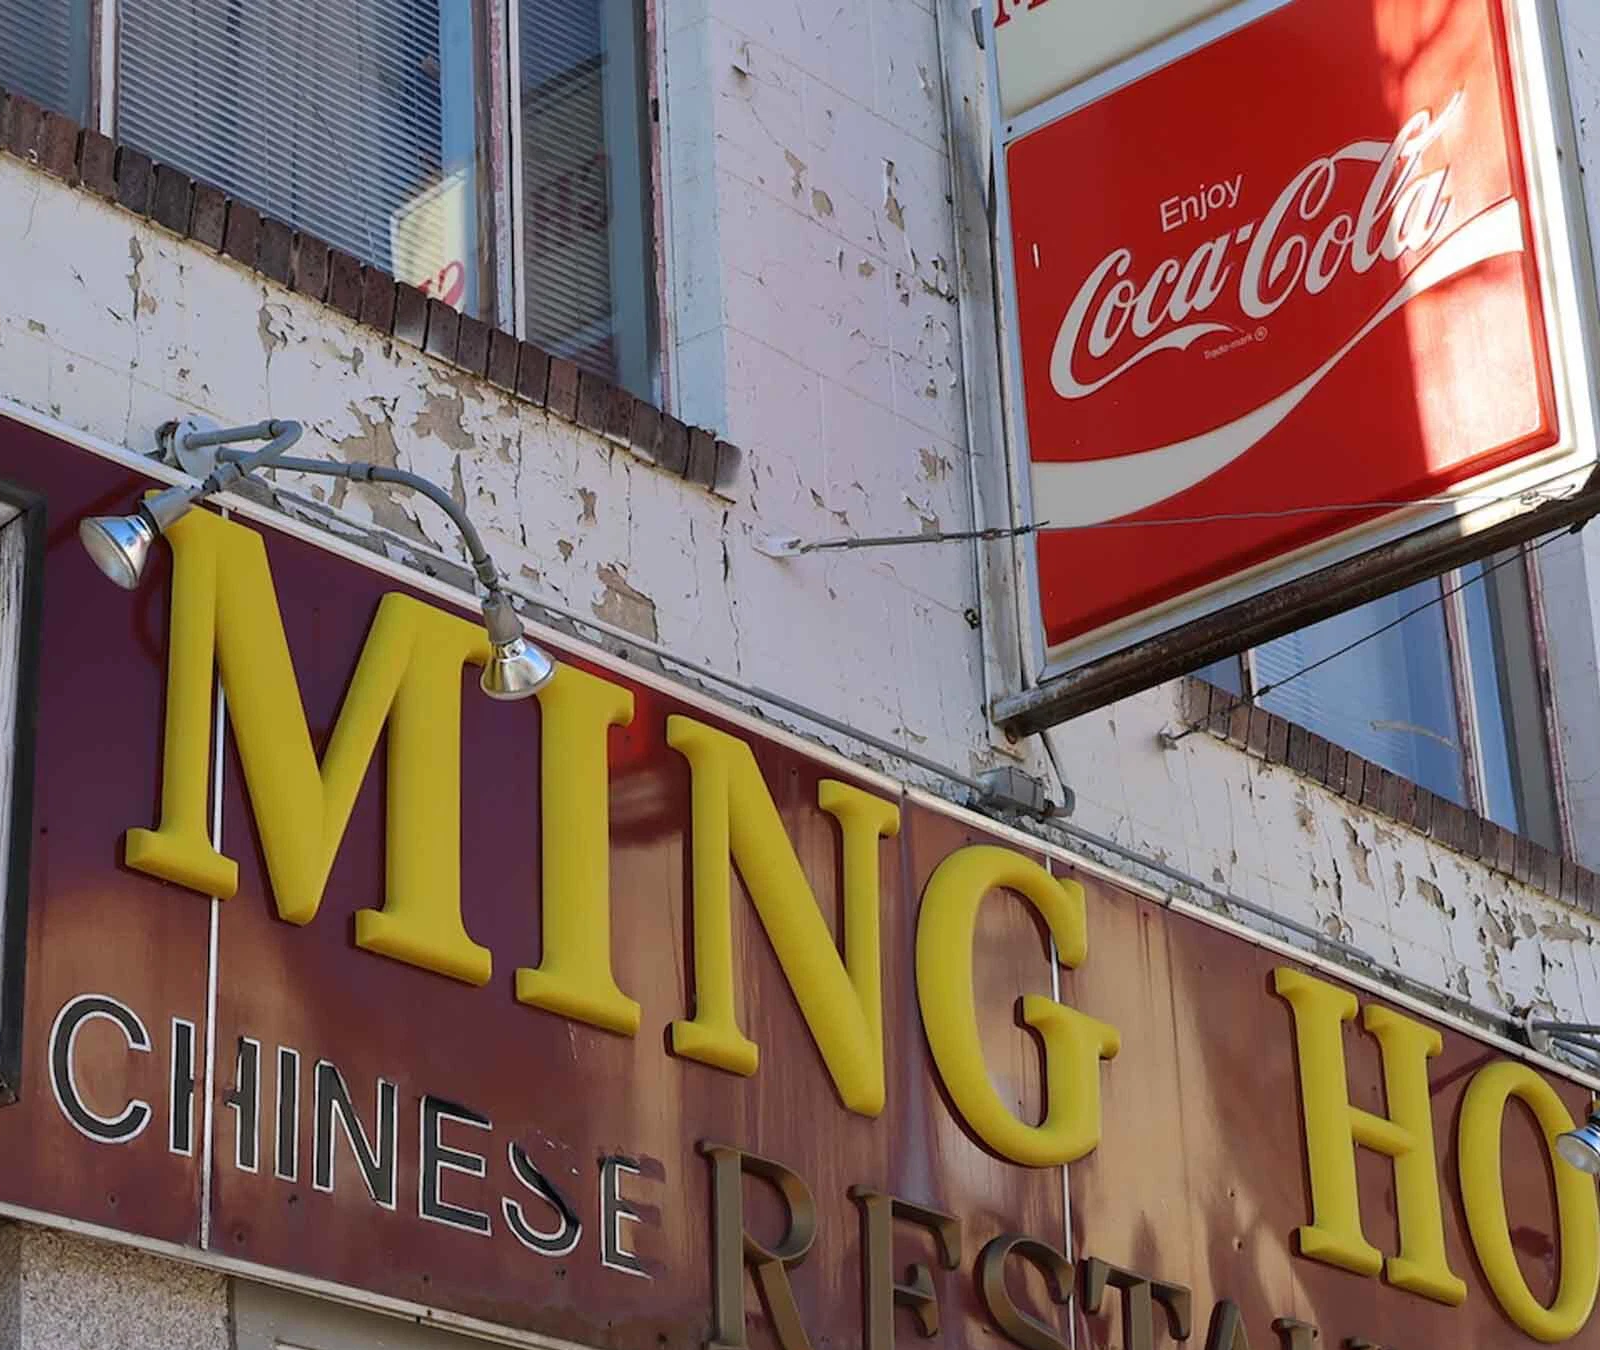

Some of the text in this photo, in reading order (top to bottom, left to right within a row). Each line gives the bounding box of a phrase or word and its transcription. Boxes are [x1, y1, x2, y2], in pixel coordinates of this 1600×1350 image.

[1049, 91, 1465, 399] Coca-Cola
[1159, 174, 1243, 233] Enjoy
[124, 495, 1119, 1168] MING
[47, 992, 662, 1280] CHINESE
